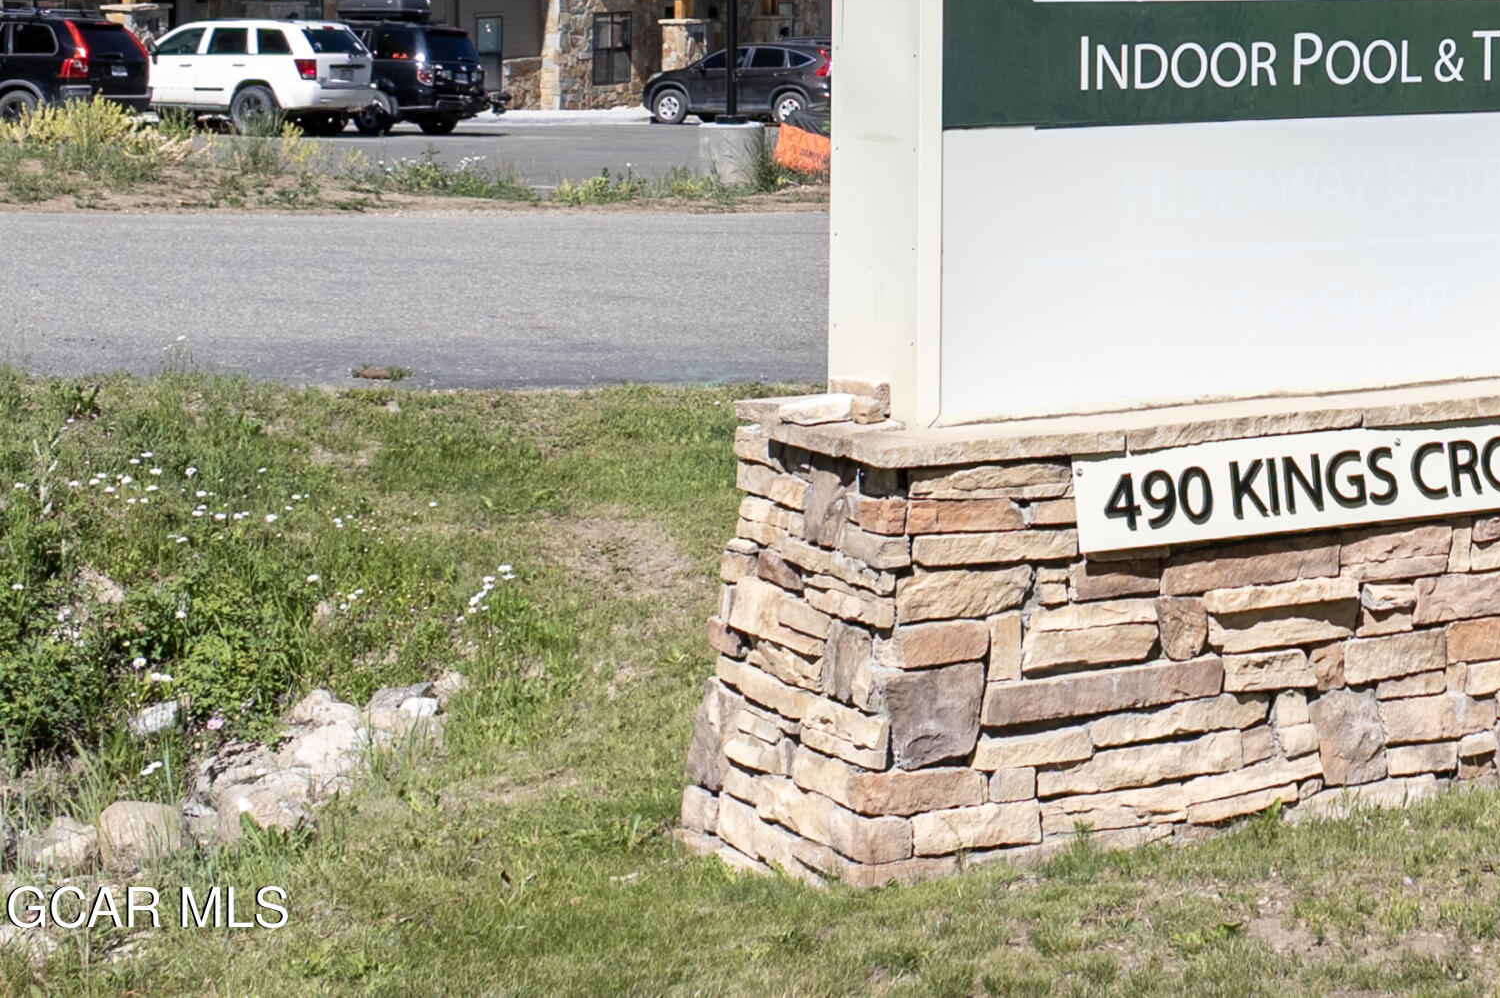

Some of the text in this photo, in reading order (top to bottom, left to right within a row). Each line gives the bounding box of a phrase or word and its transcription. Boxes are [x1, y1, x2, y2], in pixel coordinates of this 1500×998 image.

[1080, 35, 1277, 91] INDOOR
[1293, 32, 1423, 86] POOL
[1434, 38, 1465, 83] &
[1103, 466, 1214, 532] 490
[1228, 445, 1400, 521] KINGS
